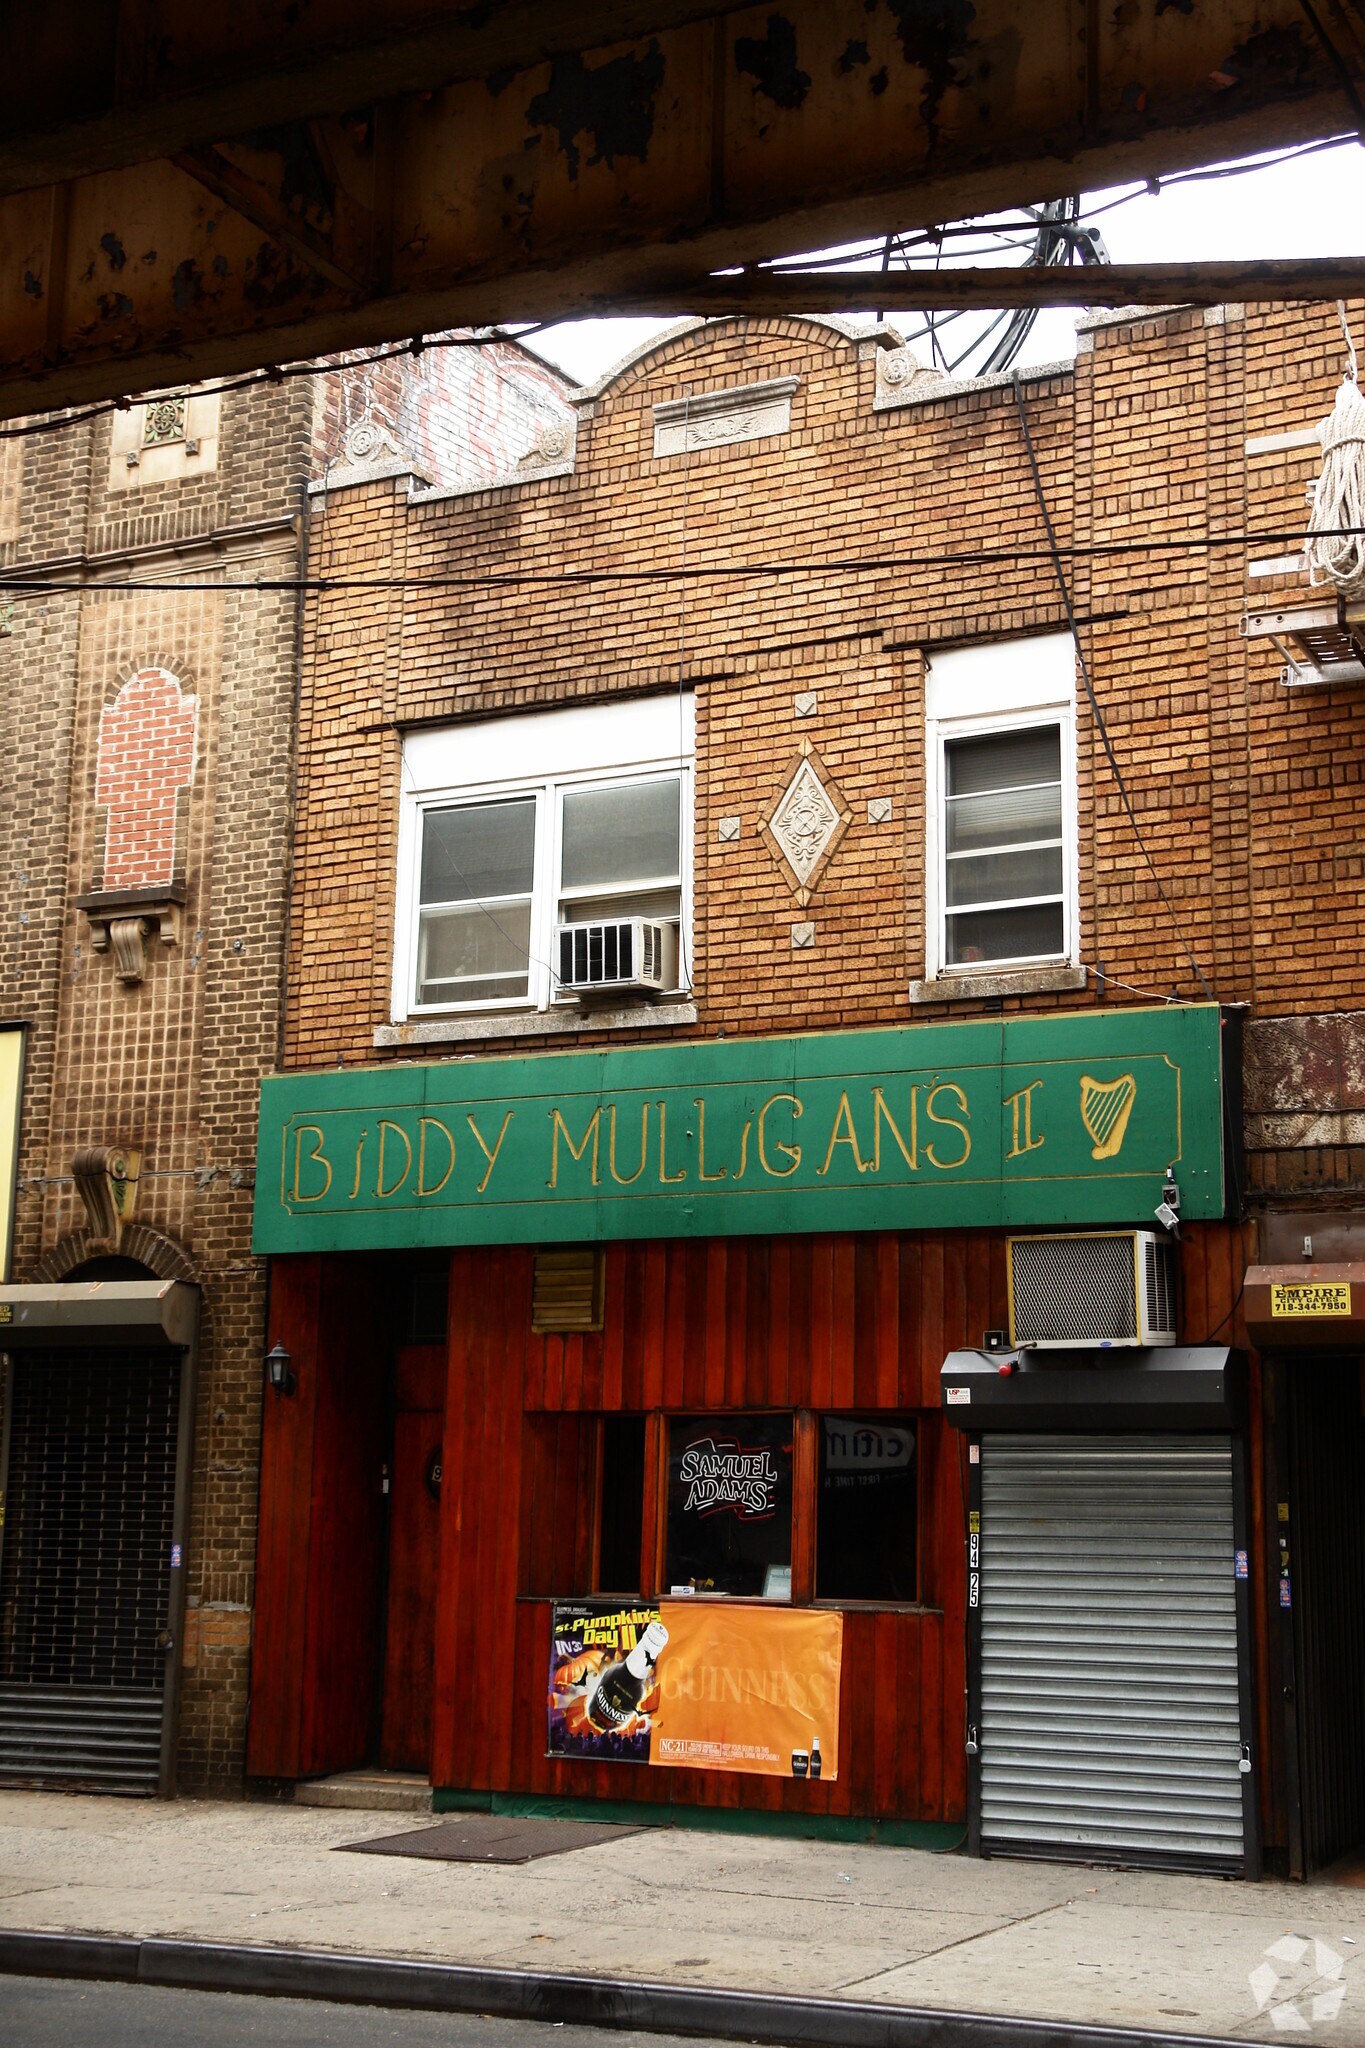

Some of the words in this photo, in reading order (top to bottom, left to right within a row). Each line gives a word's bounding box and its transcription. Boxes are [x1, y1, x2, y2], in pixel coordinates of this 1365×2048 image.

[1002, 1078, 1045, 1162] II
[1275, 1288, 1346, 1299] EMPIRE
[1275, 1302, 1347, 1311] 718-344-7950
[680, 1451, 778, 1482] SAMUEL
[684, 1480, 769, 1511] ADAMS
[572, 1609, 662, 1632] Pumpkin's
[555, 1640, 573, 1656] IN
[572, 1641, 583, 1653] 3D
[583, 1629, 619, 1649] Day
[660, 1656, 826, 1710] GUINNESS
[661, 1740, 685, 1752] NC-21
